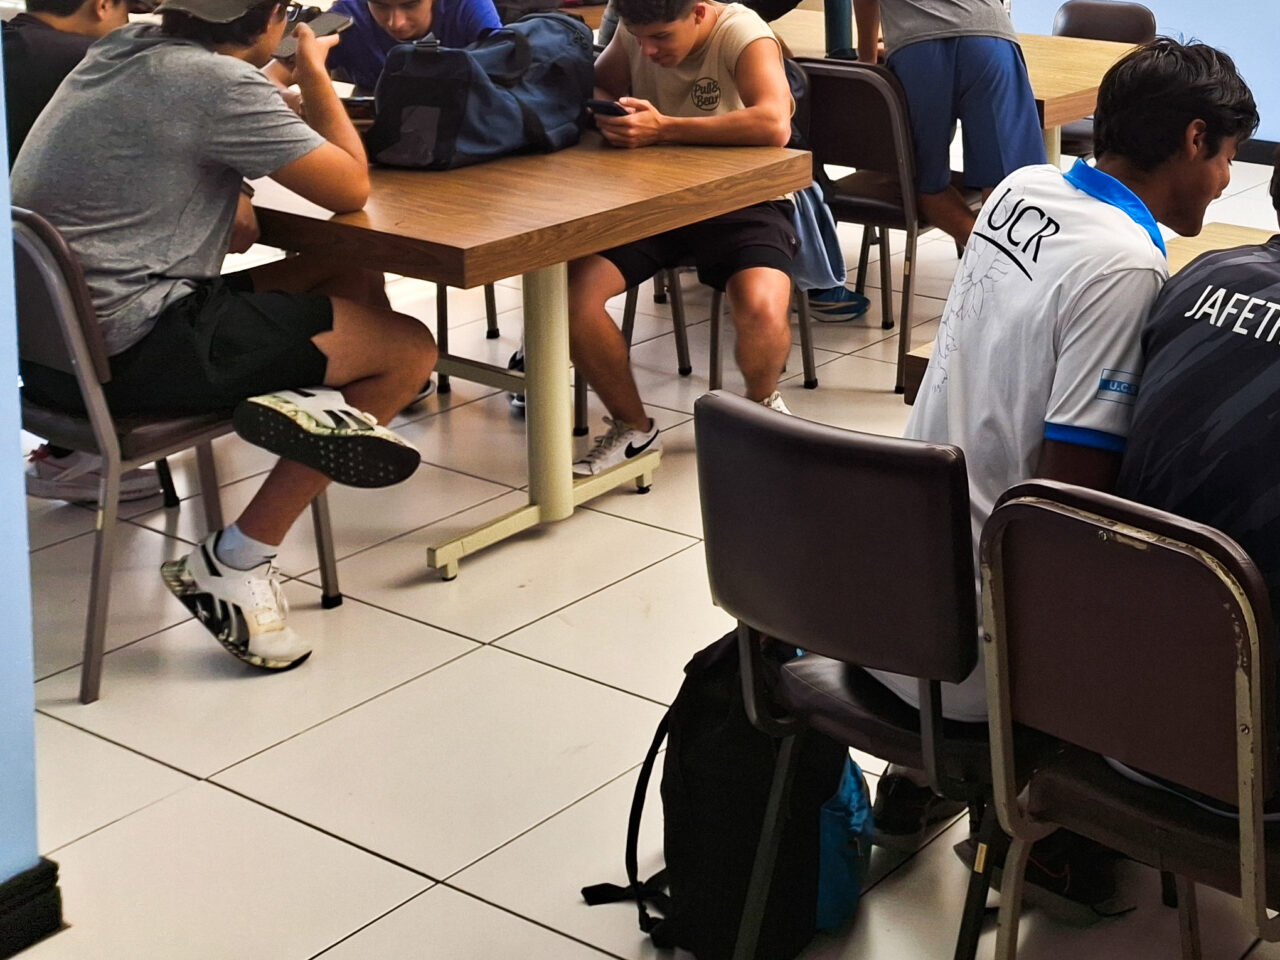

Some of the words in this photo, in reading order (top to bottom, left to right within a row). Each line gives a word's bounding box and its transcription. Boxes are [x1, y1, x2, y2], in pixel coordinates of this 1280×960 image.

[693, 80, 720, 97] Pull&
[696, 94, 719, 107] Bear
[987, 188, 1061, 263] UCR
